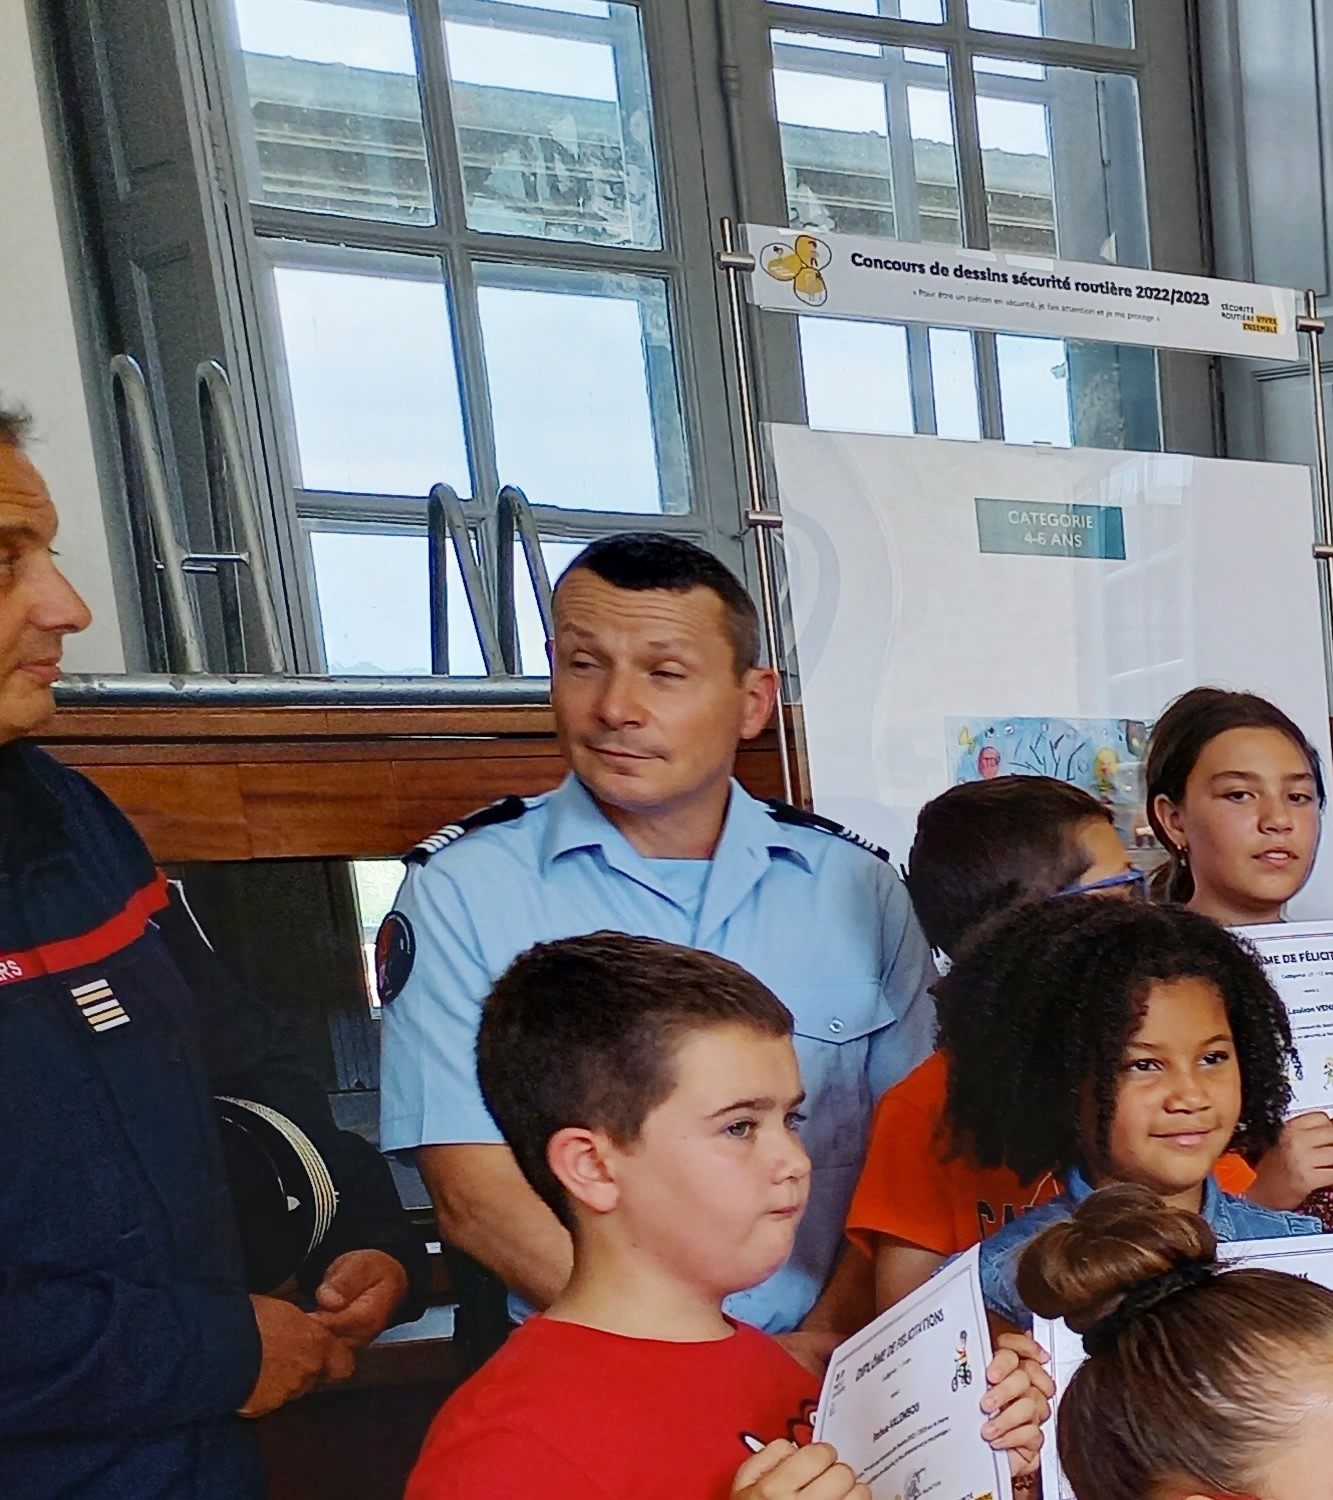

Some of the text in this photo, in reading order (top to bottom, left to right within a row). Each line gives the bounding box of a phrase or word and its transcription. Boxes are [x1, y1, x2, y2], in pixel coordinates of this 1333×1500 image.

[851, 252, 1210, 306] Concours de dessins sécurité routière 2022/2023
[1008, 510, 1094, 529] CATEGORIE
[1024, 532, 1082, 548] 4-6 ANS
[1282, 954, 1297, 964] DE
